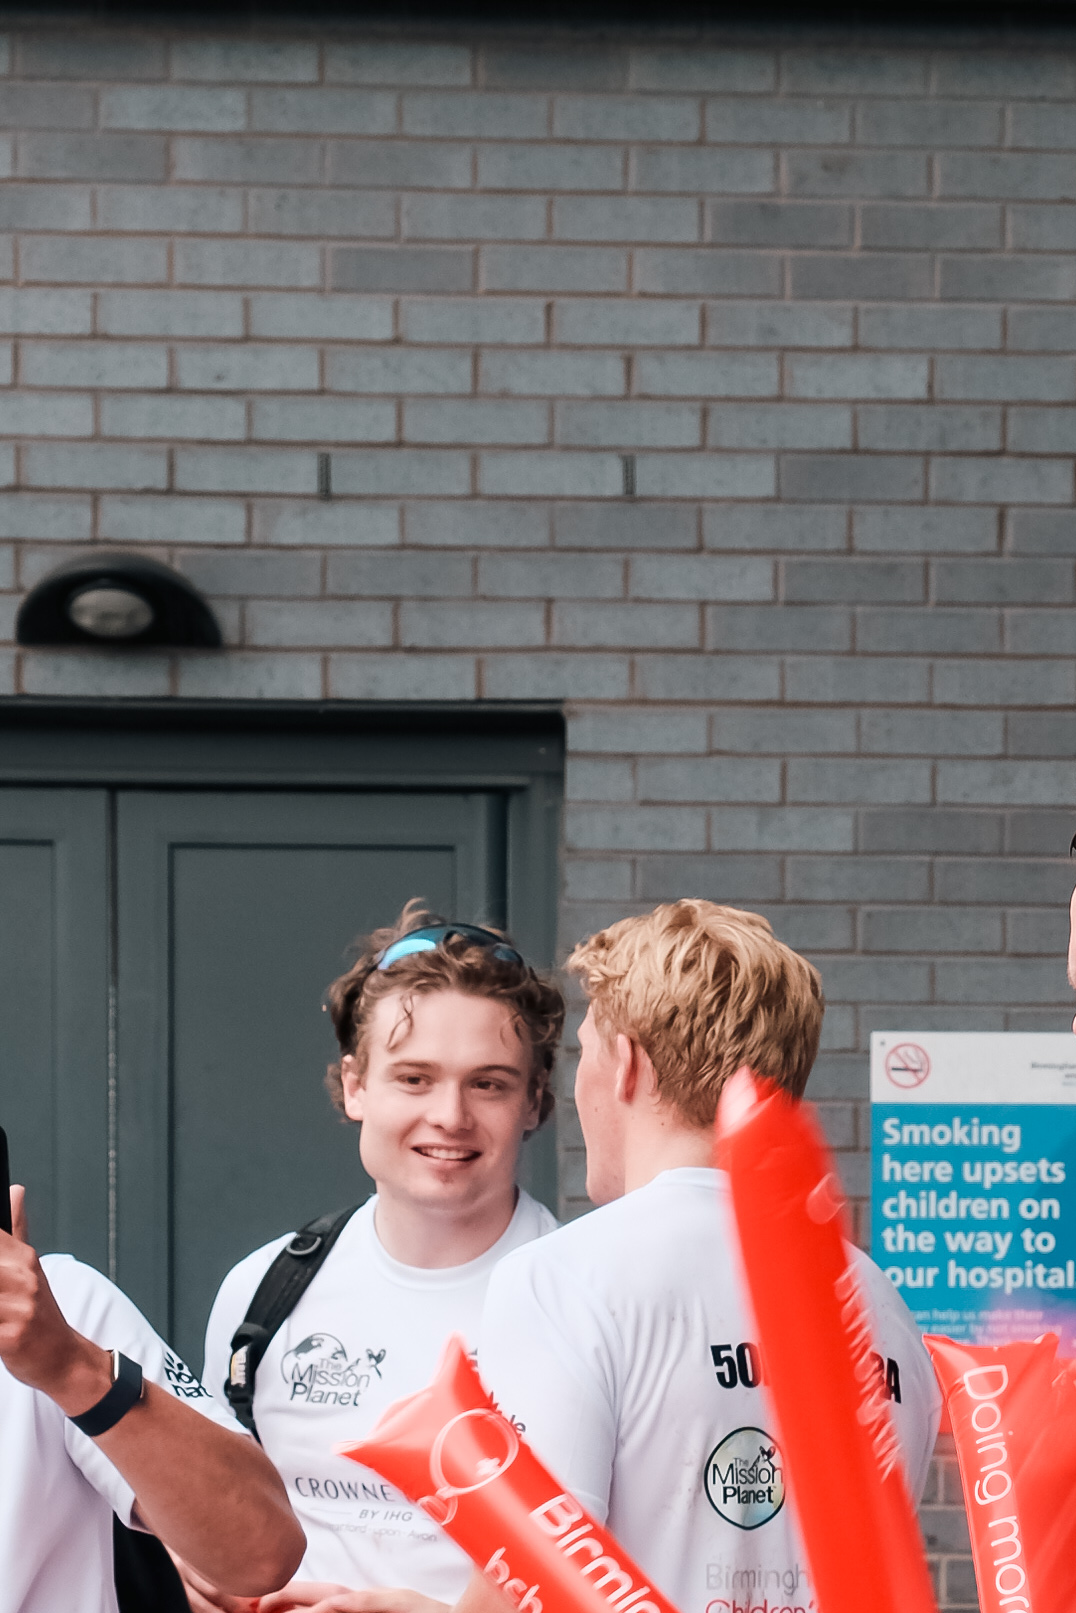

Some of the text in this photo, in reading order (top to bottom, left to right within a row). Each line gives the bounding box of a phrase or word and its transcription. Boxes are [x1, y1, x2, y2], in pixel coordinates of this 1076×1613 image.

[882, 1116, 1022, 1153] Smoking
[881, 1153, 1066, 1190] here upsets
[881, 1189, 1061, 1221] children on
[881, 1223, 1057, 1261] the way to
[884, 1265, 940, 1289] our
[291, 1362, 371, 1389] Mission
[318, 1357, 343, 1370] The
[290, 1381, 362, 1407] Planet
[963, 1364, 1015, 1506] Doing
[711, 1462, 784, 1485] Mission
[733, 1456, 749, 1468] The
[294, 1476, 392, 1502] CROWNE
[722, 1485, 775, 1504] Planet
[358, 1508, 414, 1523] BY IHG
